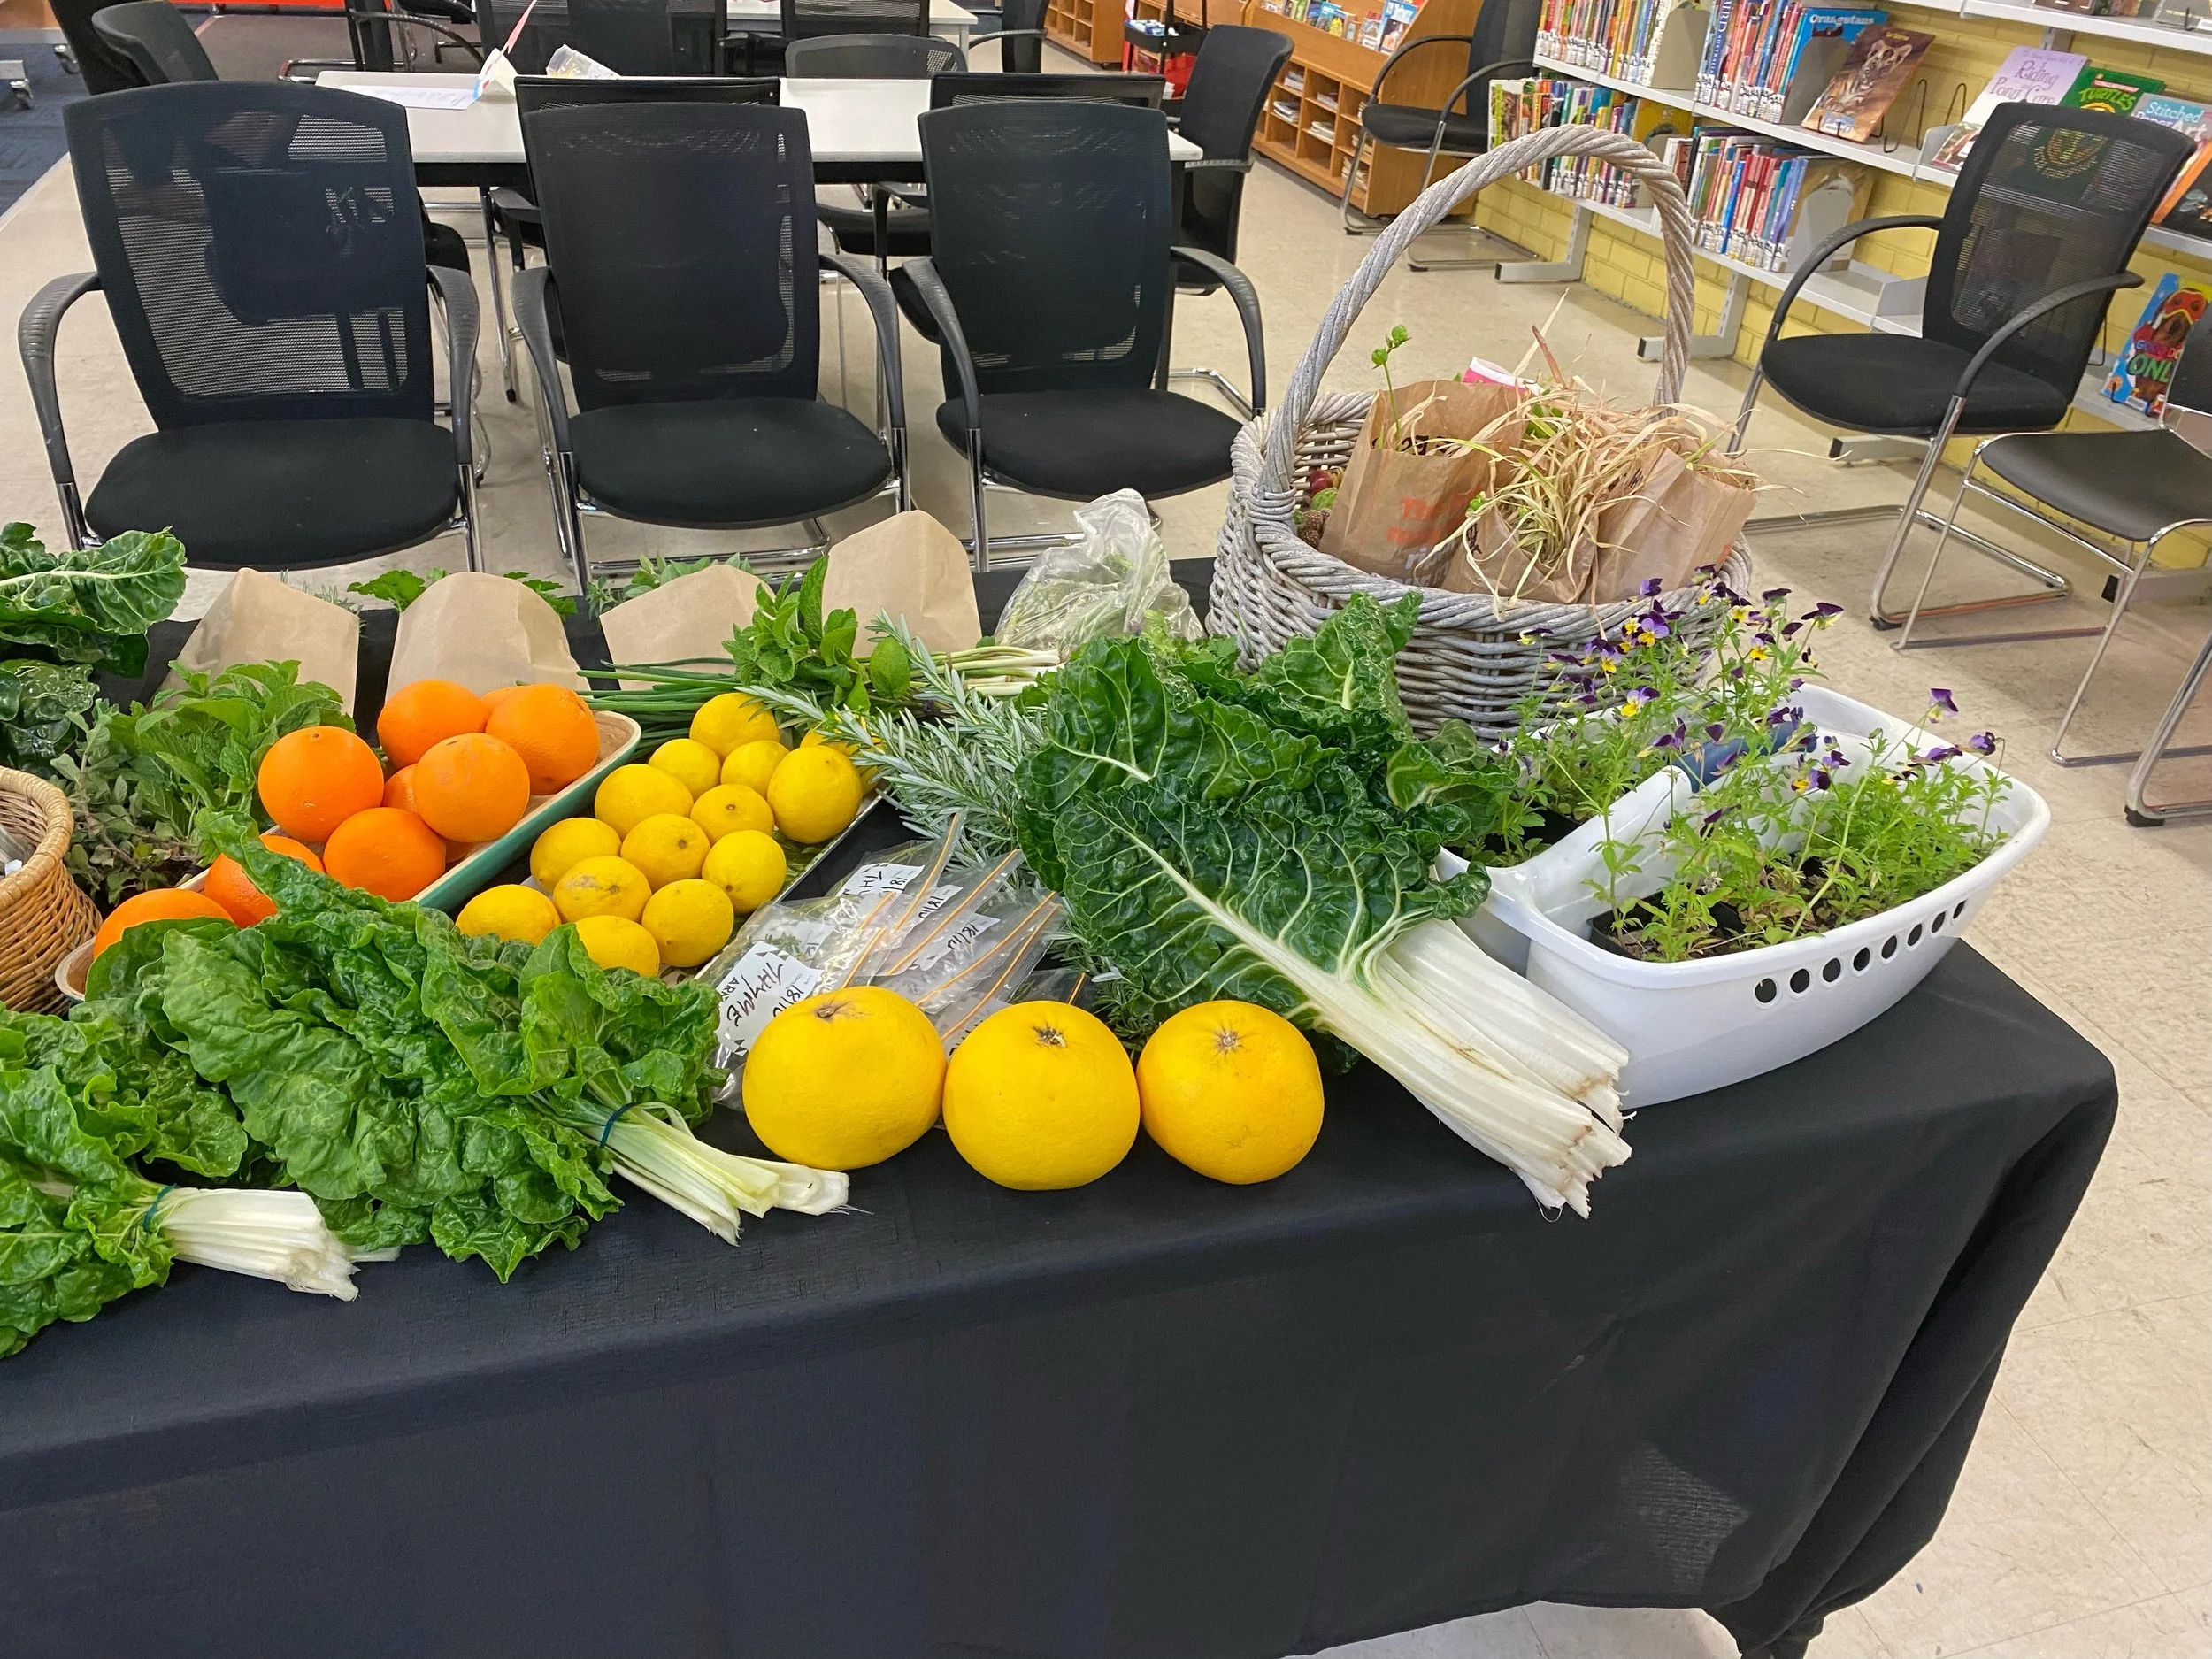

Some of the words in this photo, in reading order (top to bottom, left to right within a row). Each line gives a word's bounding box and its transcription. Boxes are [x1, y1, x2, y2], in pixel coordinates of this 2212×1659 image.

[1809, 14, 1874, 27] Orangutans
[1709, 35, 1722, 73] AUSTRALIA
[2014, 60, 2059, 88] Riding
[1989, 76, 2024, 101] Pony
[2078, 88, 2137, 111] TURTLES
[2146, 101, 2205, 123] Stitched
[726, 962, 784, 1027] THYME
